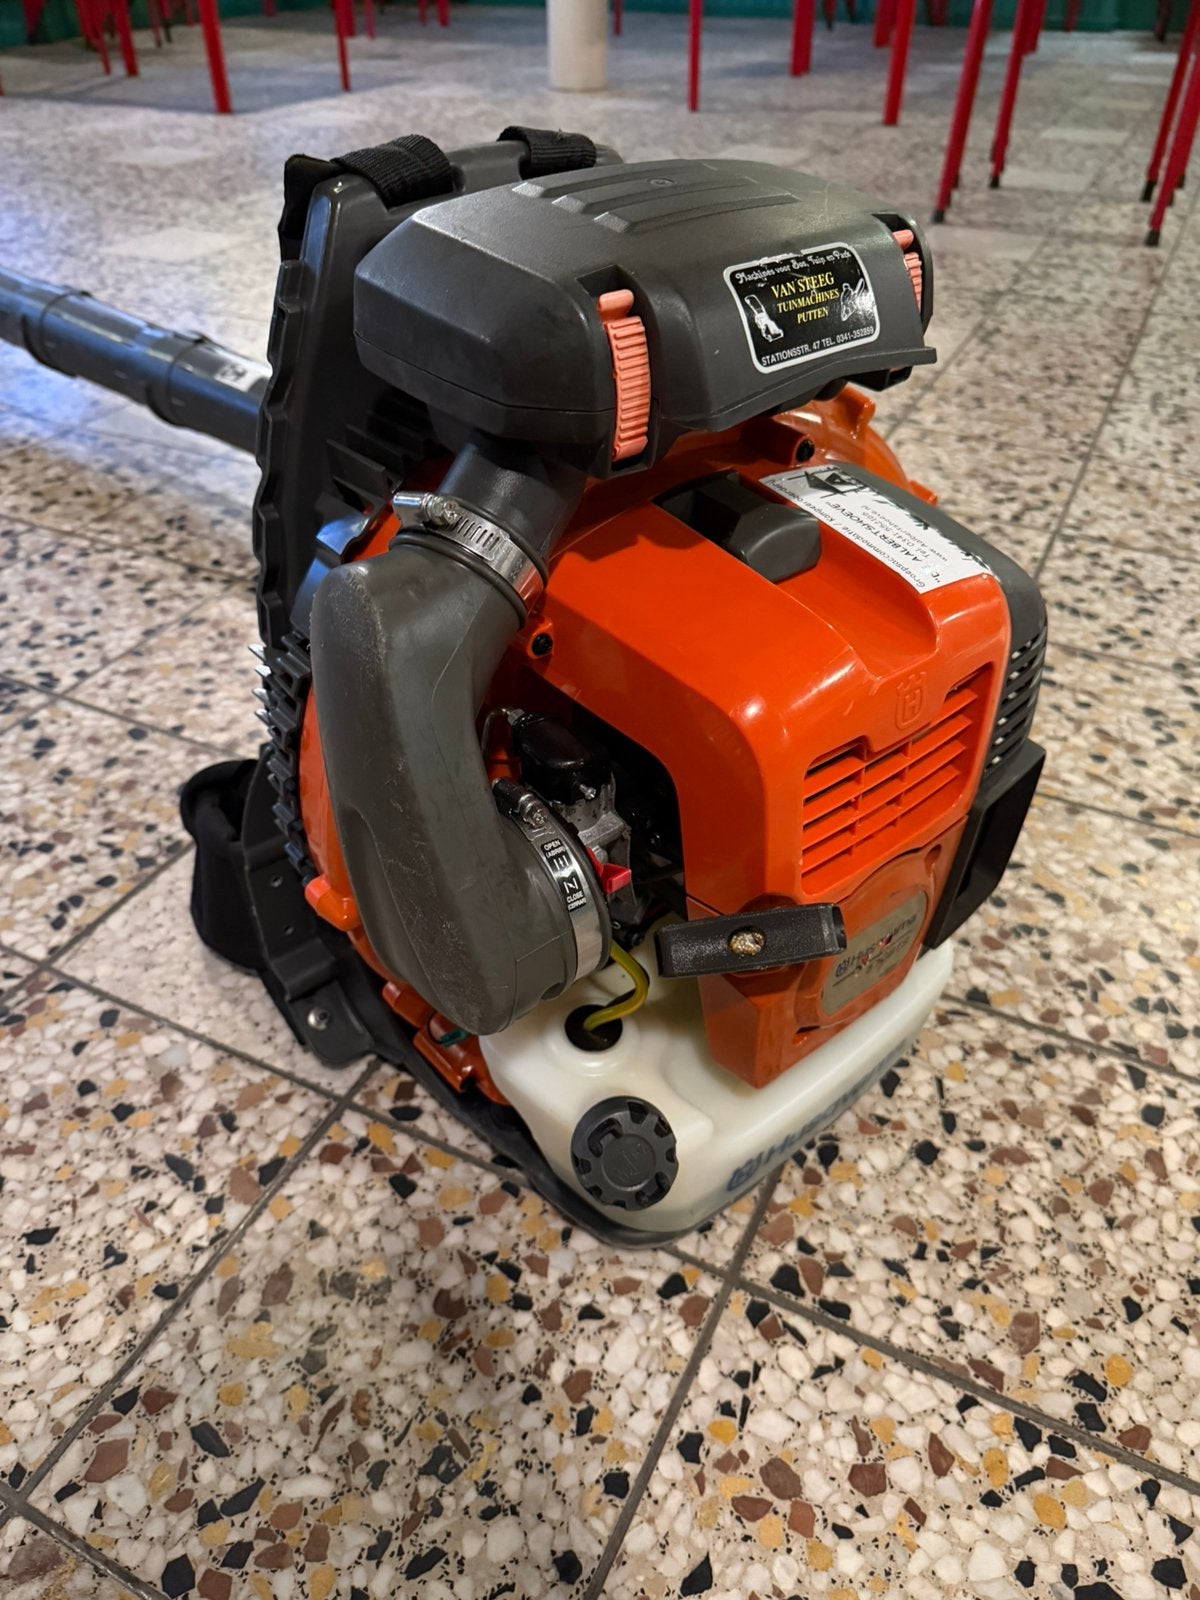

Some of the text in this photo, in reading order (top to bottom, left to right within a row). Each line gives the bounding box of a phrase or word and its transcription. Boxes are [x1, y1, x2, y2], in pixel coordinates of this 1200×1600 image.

[735, 269, 776, 284] Machines
[775, 264, 791, 277] voor
[771, 272, 835, 299] VAN STEEG
[777, 288, 840, 314] TUINMACHINES
[797, 306, 829, 324] PUTTEN
[761, 326, 875, 367] STATIONSSTR. 47 TEL. 0341-352859
[842, 526, 925, 588] Groepsaccommodatie
[543, 839, 561, 851] OPEN
[566, 890, 584, 903] CLOSE
